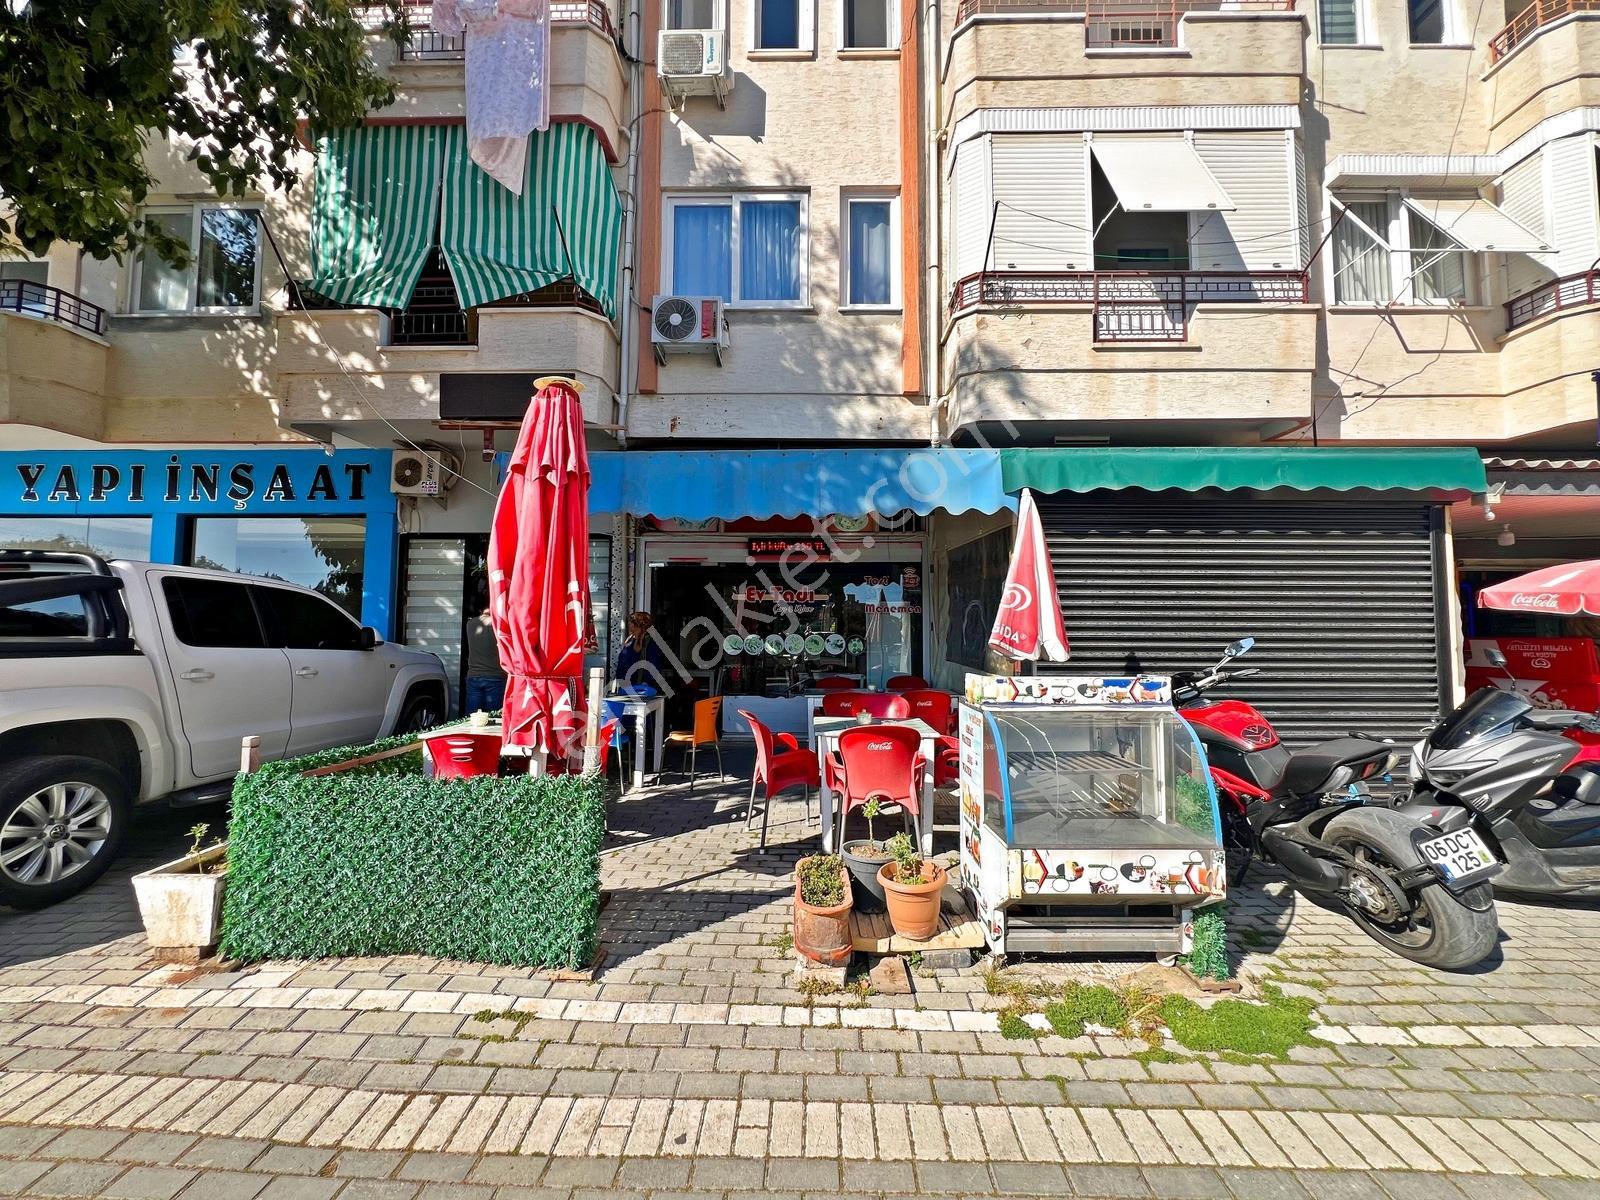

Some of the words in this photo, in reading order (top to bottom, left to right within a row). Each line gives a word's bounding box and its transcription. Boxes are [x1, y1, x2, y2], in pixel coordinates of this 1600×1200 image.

[16, 464, 145, 501] YAPI
[164, 454, 370, 510] İNŞAAT
[746, 586, 766, 603] Ev
[1511, 593, 1560, 608] Coca-Cola
[865, 604, 921, 613] Menemen
[867, 742, 893, 750] Coca-Cola
[1443, 829, 1478, 854] DCT
[1452, 850, 1481, 873] 125
